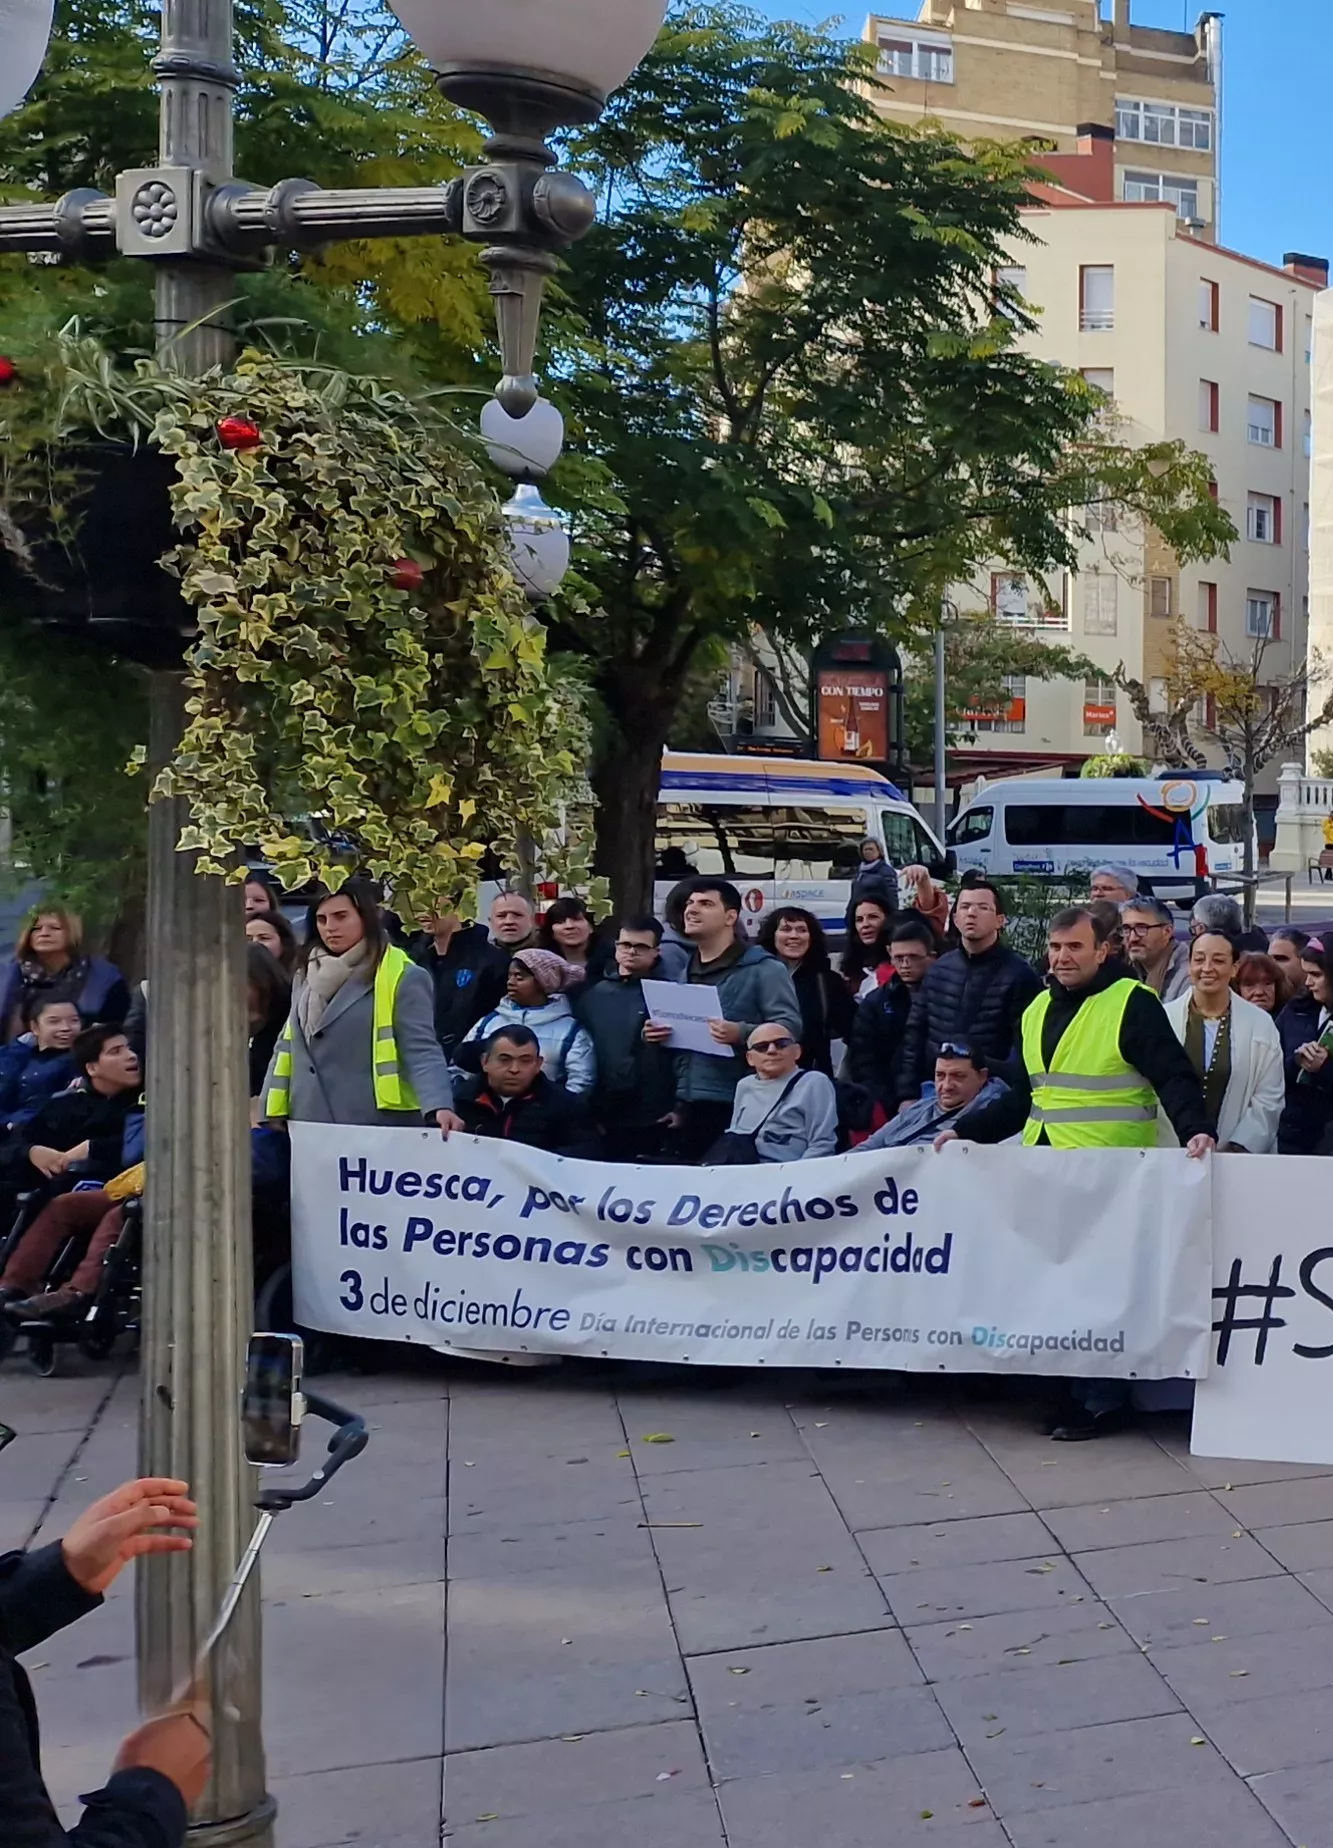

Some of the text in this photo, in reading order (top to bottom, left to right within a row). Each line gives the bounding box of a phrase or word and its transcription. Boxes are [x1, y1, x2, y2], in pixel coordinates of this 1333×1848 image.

[821, 686, 884, 697] CON TIEMPO
[338, 1156, 919, 1229] Huesca, por los Derechos de
[339, 1207, 953, 1286] las Personas con Discapacidad
[338, 1269, 571, 1331] 3 de diciembre
[579, 1311, 617, 1333] Día
[624, 1314, 775, 1341] Internacional
[777, 1318, 800, 1341] de
[806, 1319, 837, 1342] las
[926, 1326, 963, 1346] con
[971, 1325, 1126, 1355] Discapacidad
